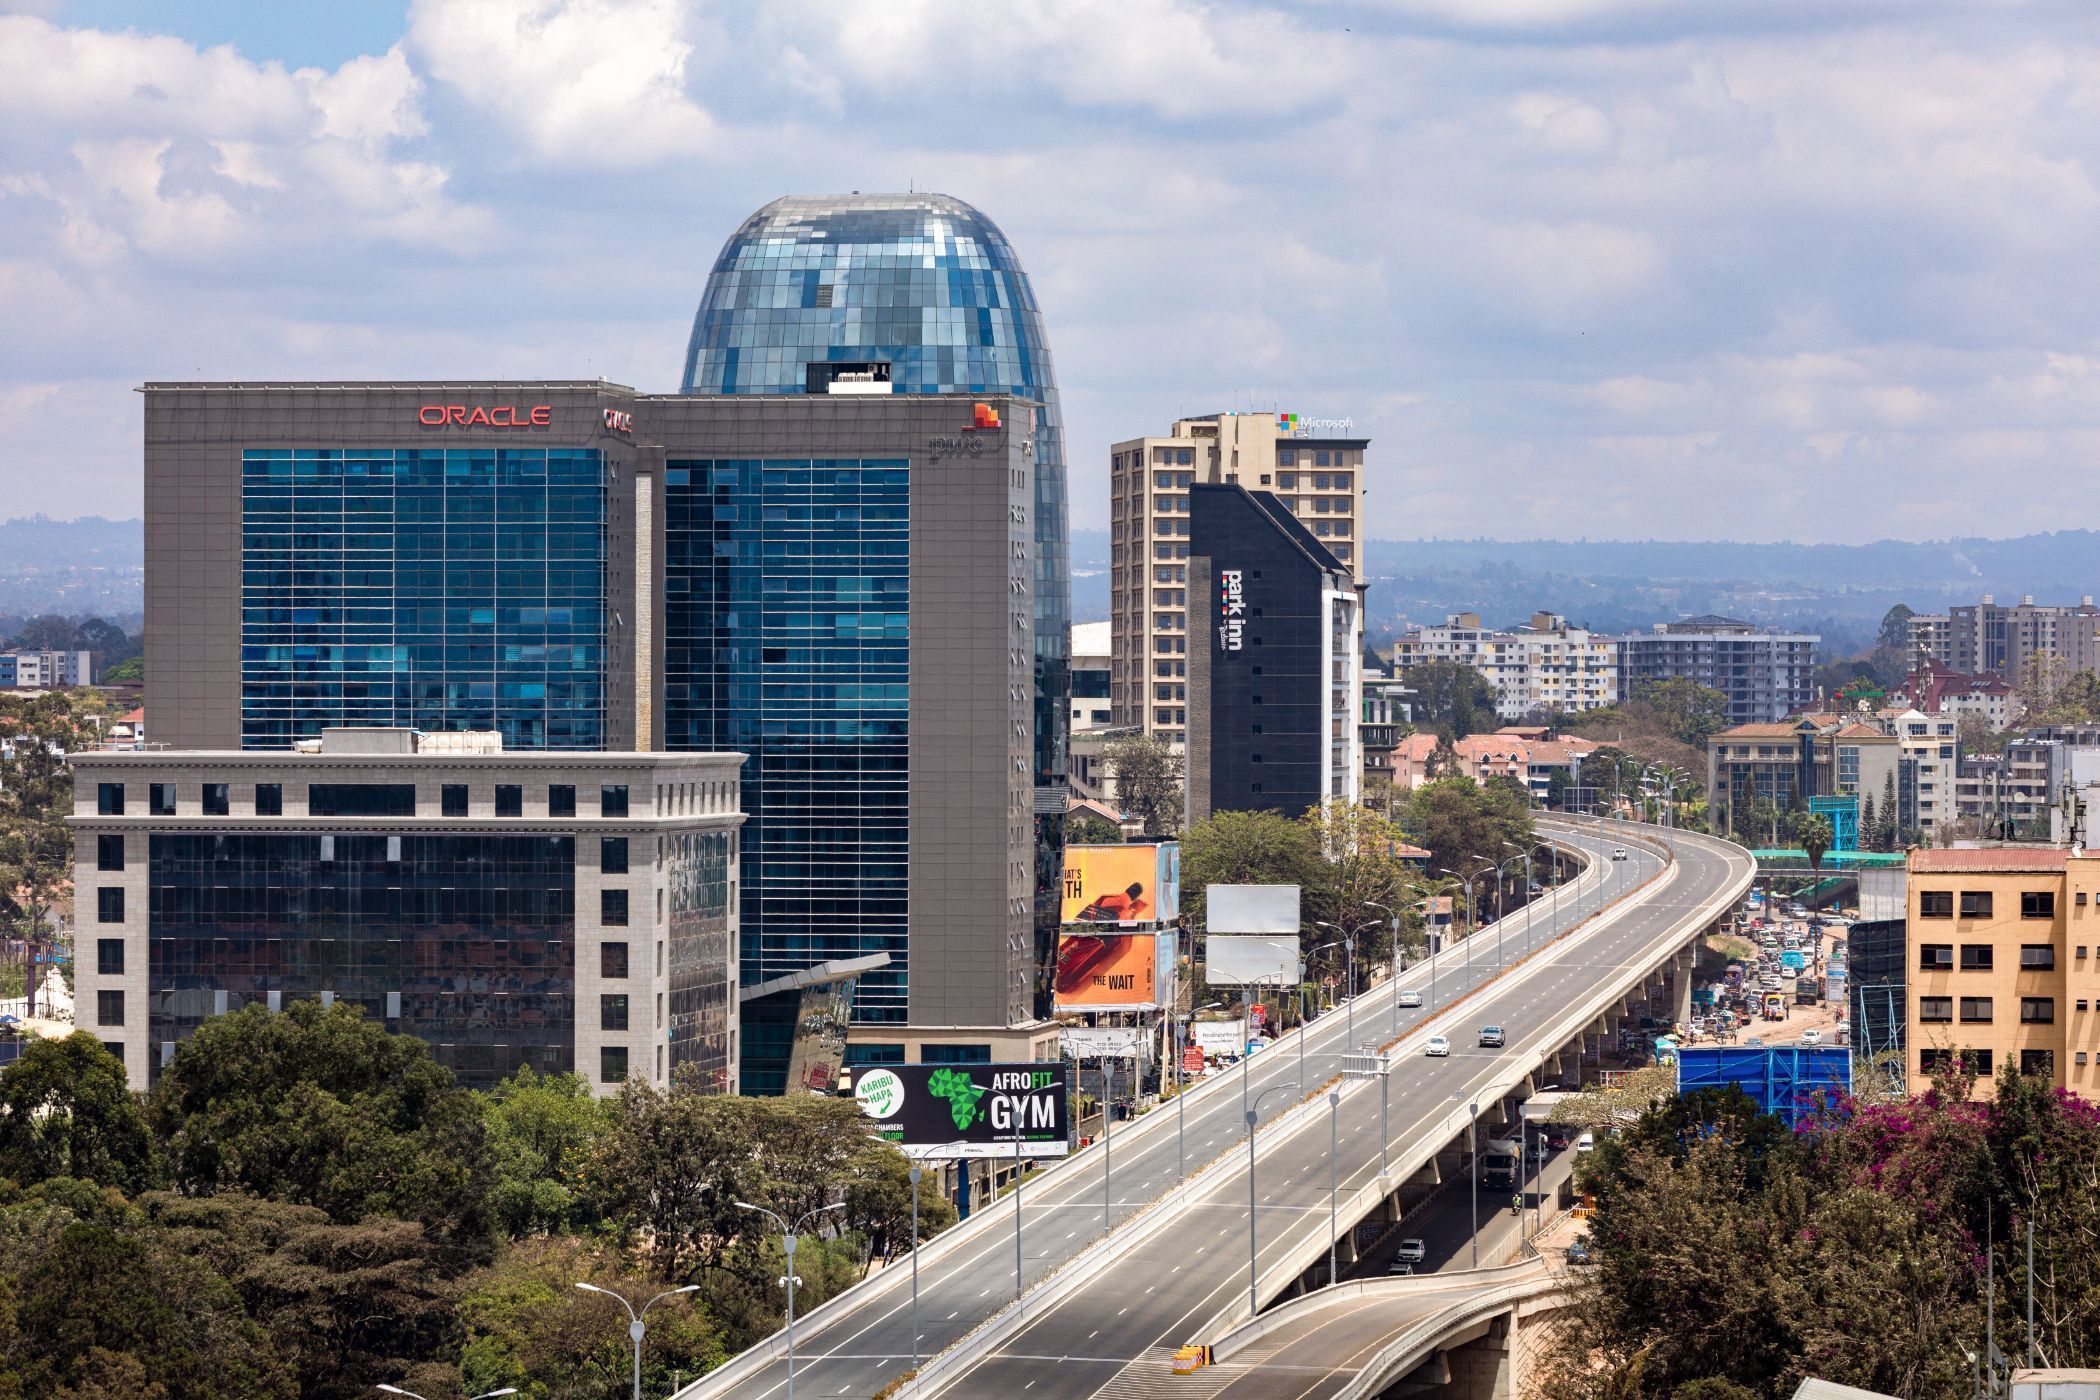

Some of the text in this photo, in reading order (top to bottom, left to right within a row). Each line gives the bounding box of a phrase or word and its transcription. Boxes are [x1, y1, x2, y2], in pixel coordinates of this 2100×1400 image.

[419, 406, 551, 426] ORACLE
[1300, 416, 1354, 428] Microsoft
[929, 435, 984, 458] pwc
[1222, 570, 1247, 651] park inn
[1063, 881, 1082, 899] TH
[1093, 975, 1106, 986] THE
[1108, 974, 1135, 990] WAIT
[860, 1075, 894, 1095] KARIBU
[992, 1071, 1053, 1090] AFROFIT
[868, 1089, 894, 1104] HAPA
[991, 1095, 1055, 1129] GYM
[874, 1123, 904, 1131] CHAMBERS
